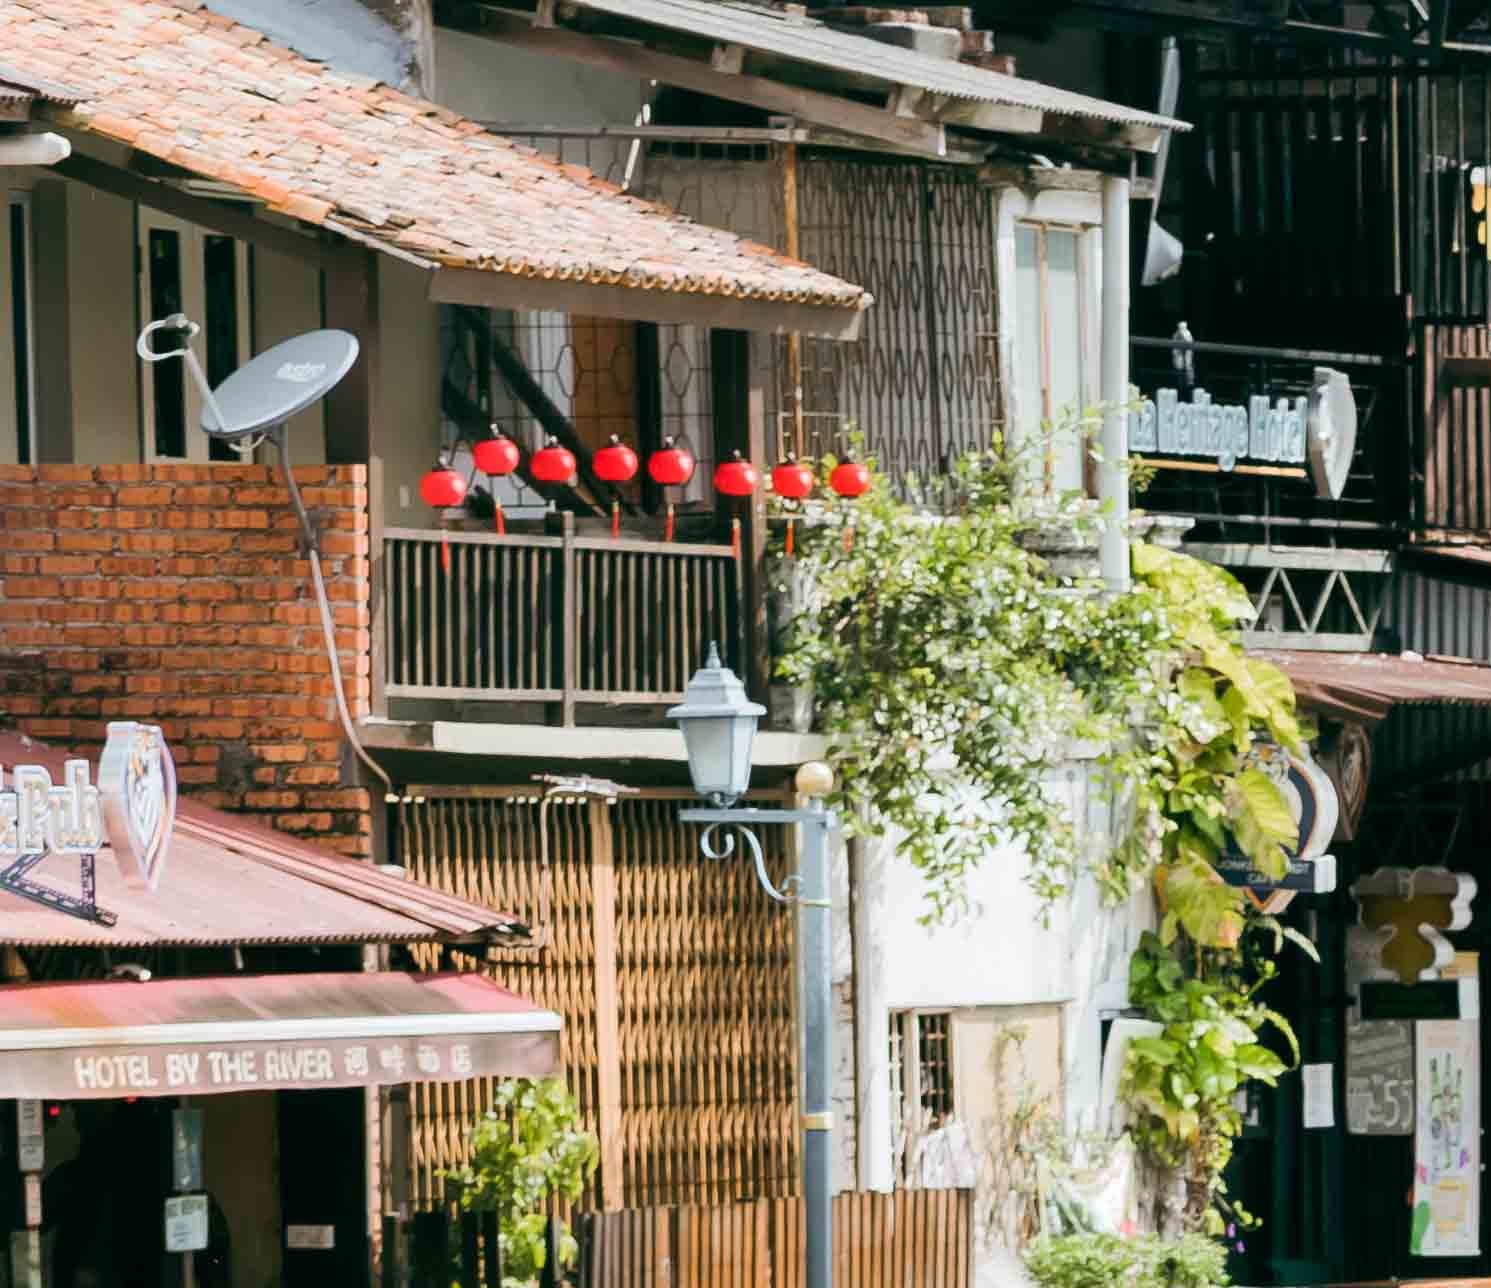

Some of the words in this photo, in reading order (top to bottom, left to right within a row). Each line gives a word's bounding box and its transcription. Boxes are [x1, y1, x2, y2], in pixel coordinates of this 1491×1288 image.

[1157, 388, 1248, 471] Heritage
[1250, 396, 1308, 463] Hotel
[14, 763, 98, 853] Pub
[74, 1054, 158, 1089] HOTEL
[165, 1051, 200, 1087] BY
[207, 1048, 259, 1084] THE
[263, 1047, 334, 1082] RIVER
